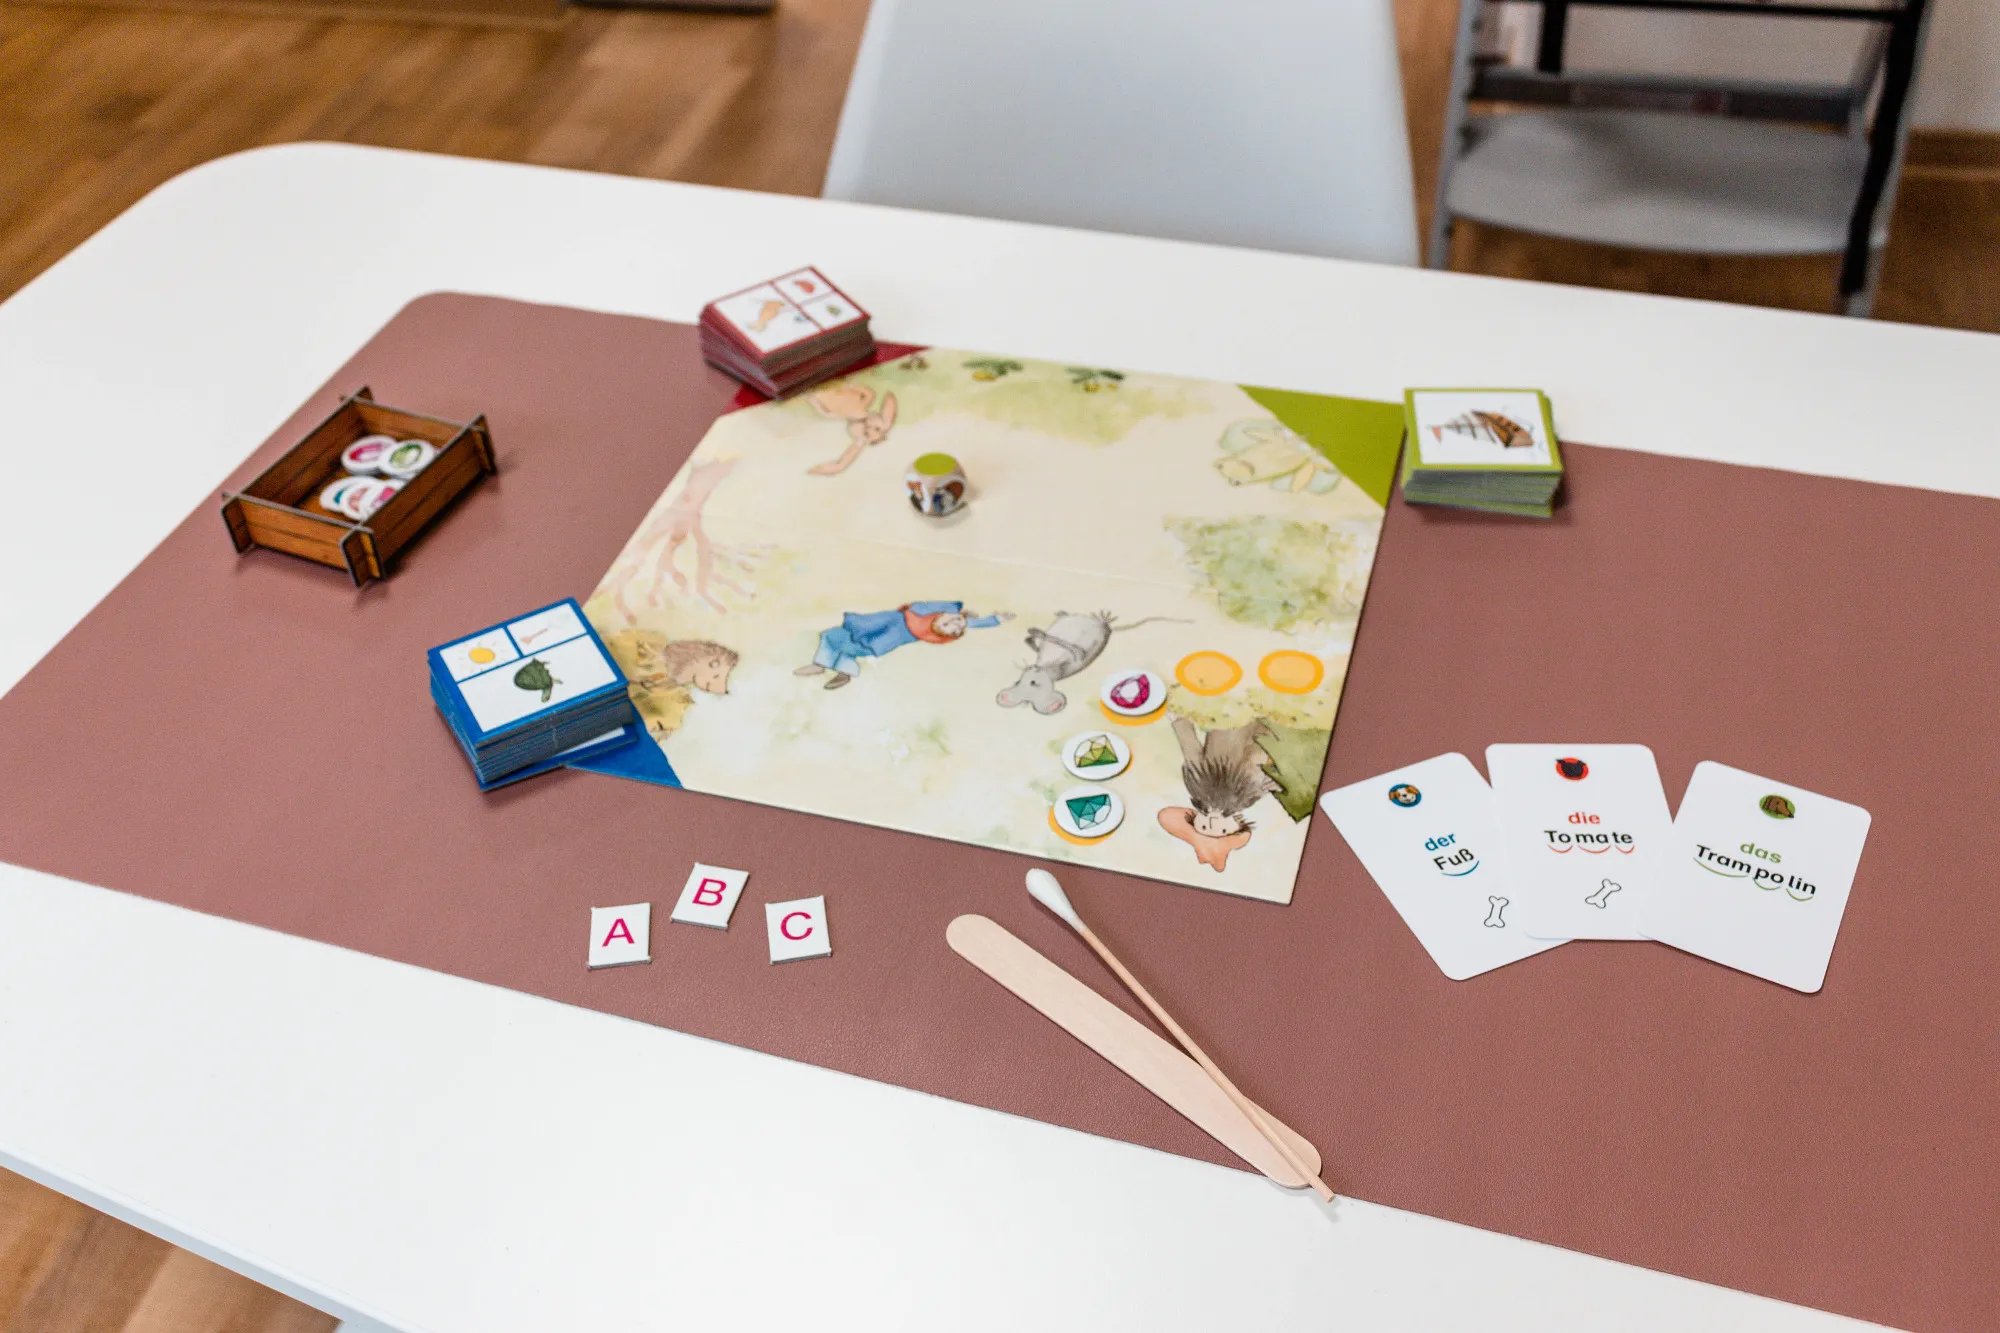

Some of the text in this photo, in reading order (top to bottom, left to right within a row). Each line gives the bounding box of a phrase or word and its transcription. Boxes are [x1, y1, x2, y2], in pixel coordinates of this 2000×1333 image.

[1568, 811, 1601, 825] die
[1424, 833, 1457, 852] der
[1740, 842, 1782, 864] das
[1433, 848, 1475, 871] Fuß
[692, 877, 727, 907] B
[602, 917, 635, 947] A
[779, 911, 813, 941] C
